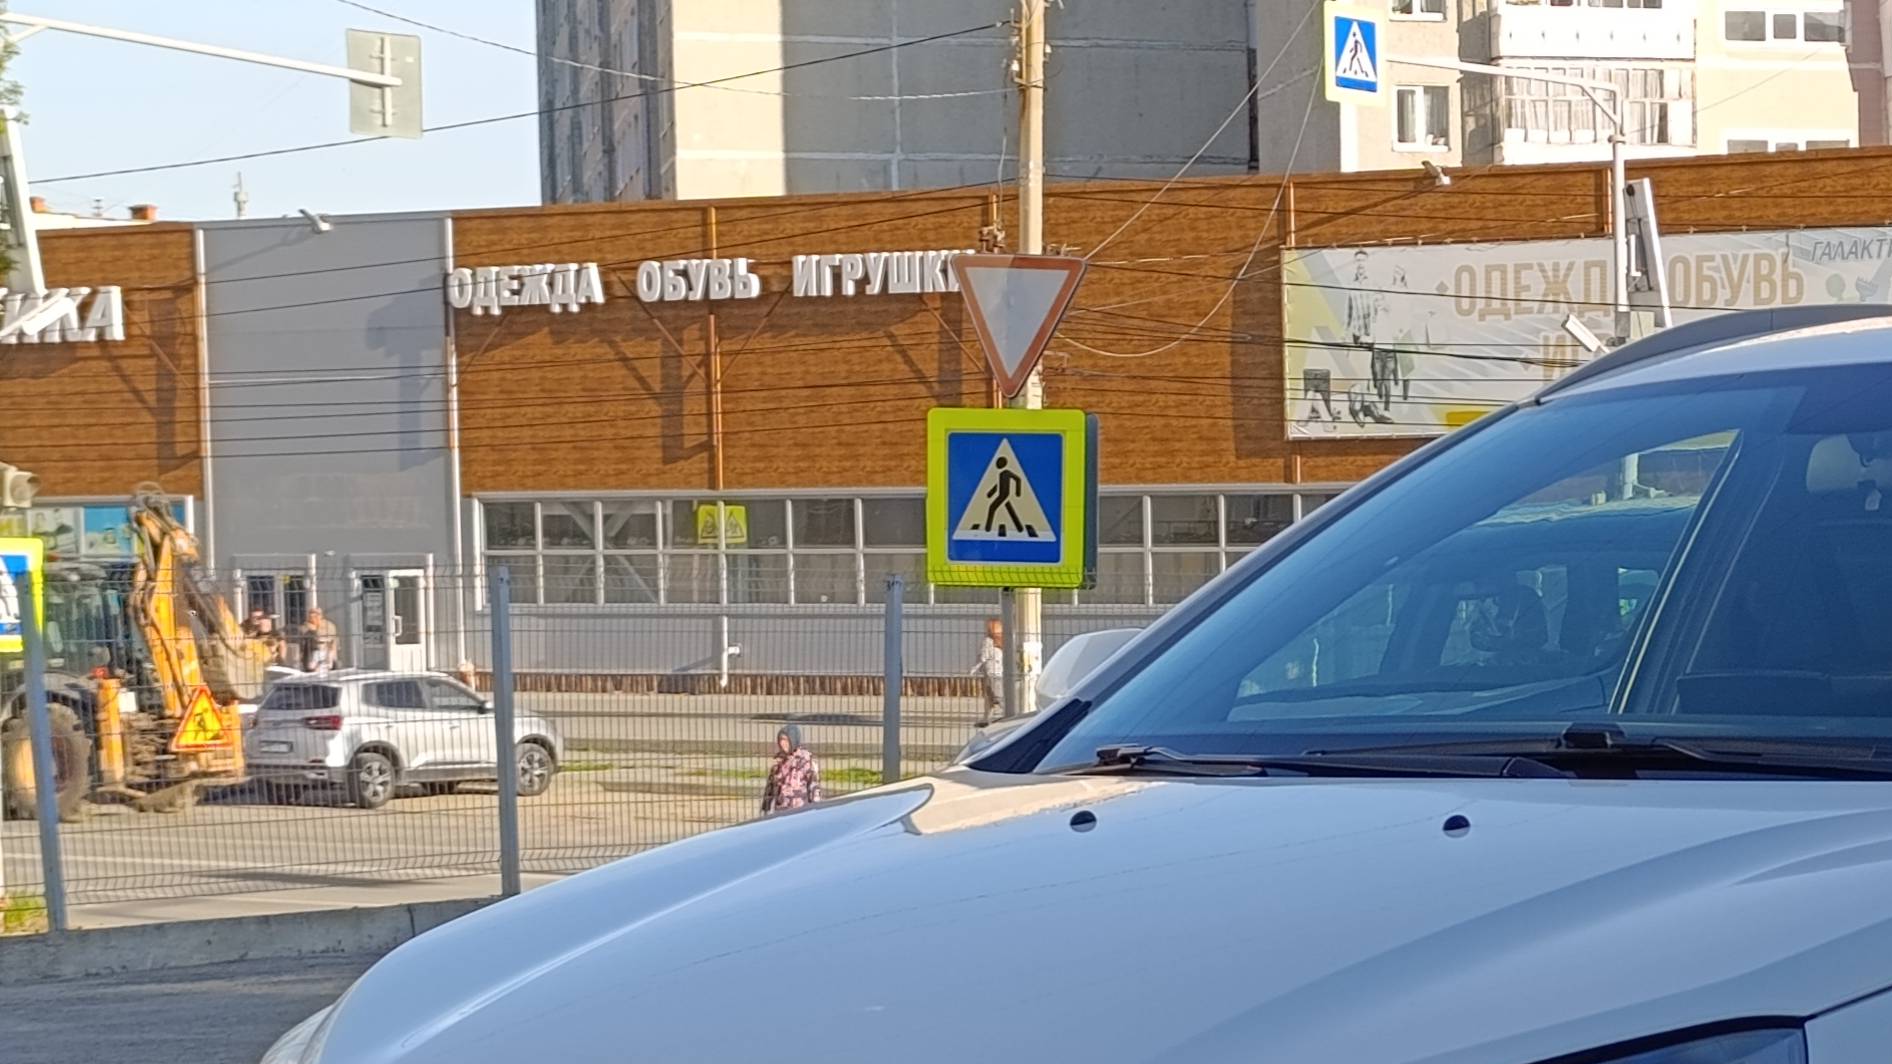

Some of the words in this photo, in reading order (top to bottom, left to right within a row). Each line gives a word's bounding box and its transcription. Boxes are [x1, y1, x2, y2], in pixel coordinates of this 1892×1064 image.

[0, 285, 125, 344] ИКА
[450, 262, 605, 315] ОДЕЖДА
[636, 257, 761, 302] ОБУВЬ
[1454, 258, 1613, 322] ОДЕЖД
[1667, 252, 1804, 308] ОБУВЬ
